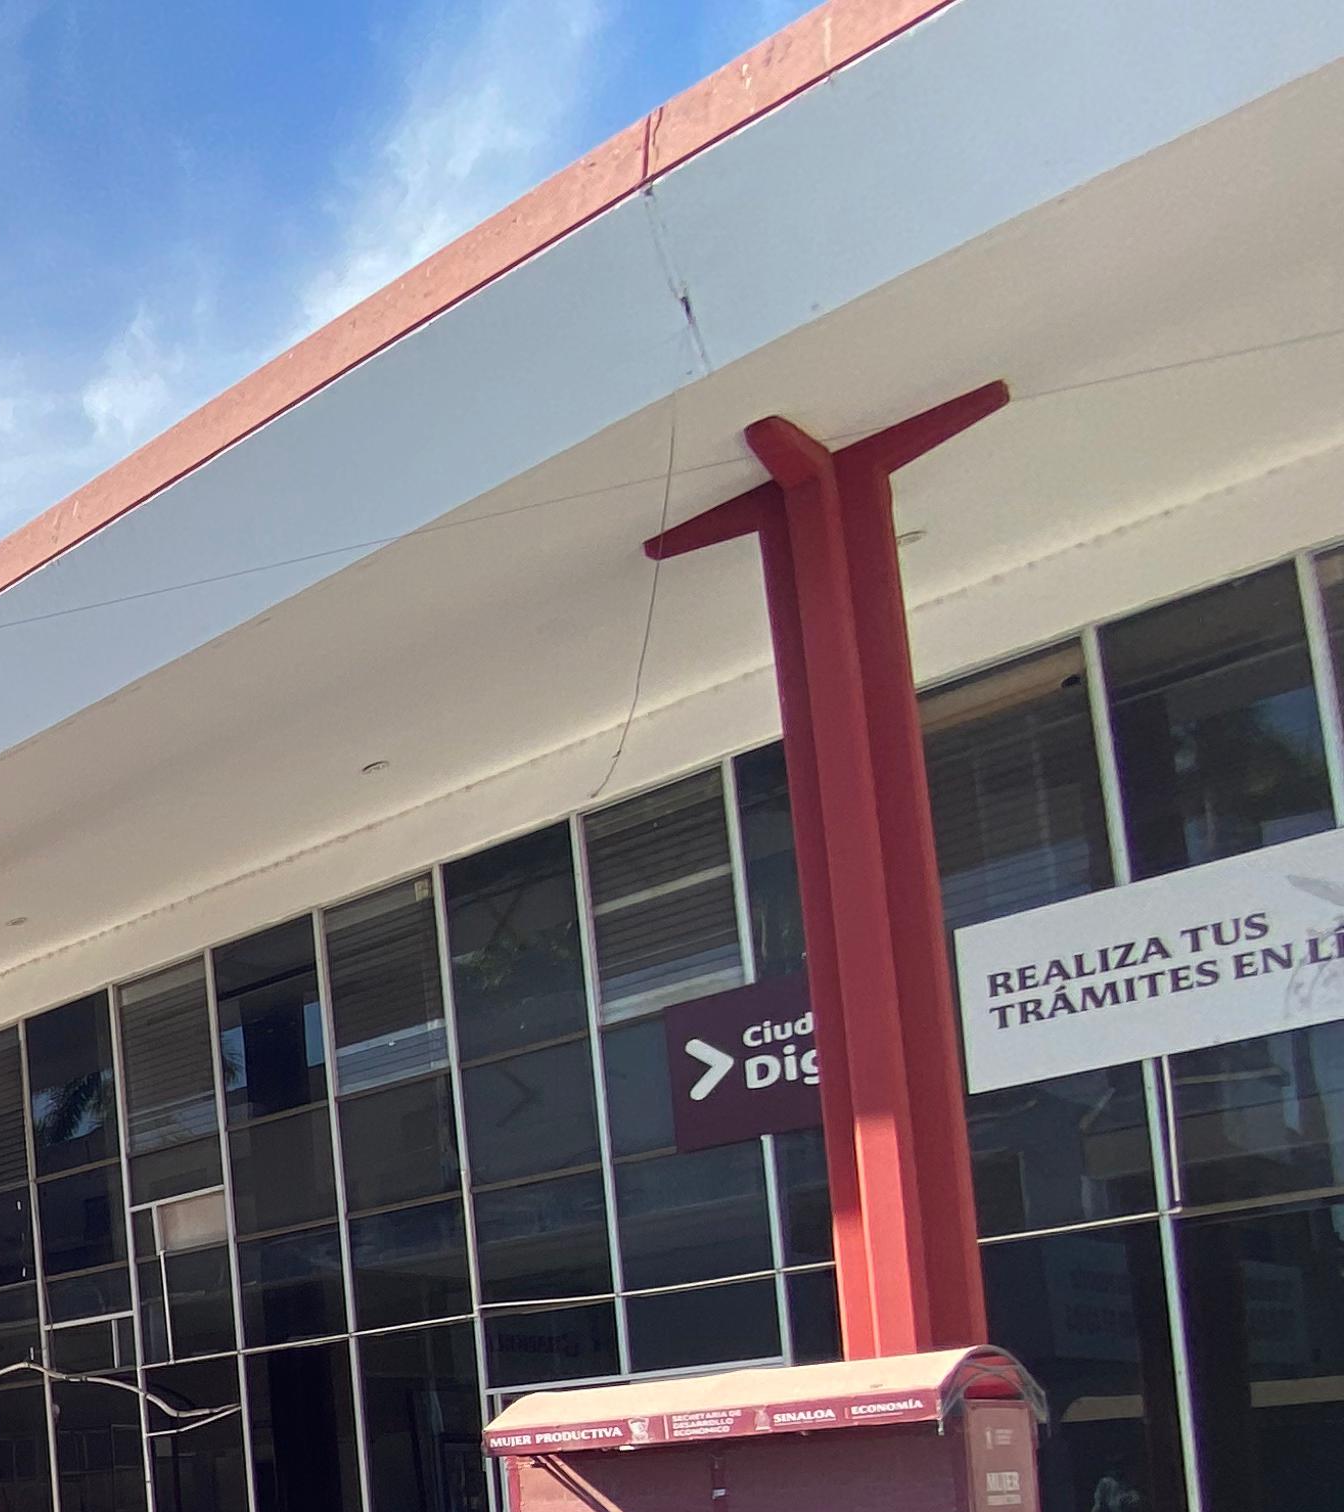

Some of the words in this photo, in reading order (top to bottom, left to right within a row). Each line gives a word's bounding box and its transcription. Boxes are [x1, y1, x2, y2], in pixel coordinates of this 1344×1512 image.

[986, 936, 1172, 998] REALIZA
[1180, 912, 1269, 953] TUS
[988, 960, 1220, 1030] TRÁMITES
[1232, 943, 1293, 979] EN
[773, 1408, 836, 1424] SINALOA
[851, 1398, 923, 1416] ECONOMÍA
[489, 1434, 531, 1449] MUJER
[535, 1426, 624, 1444] PRODUCTIVA
